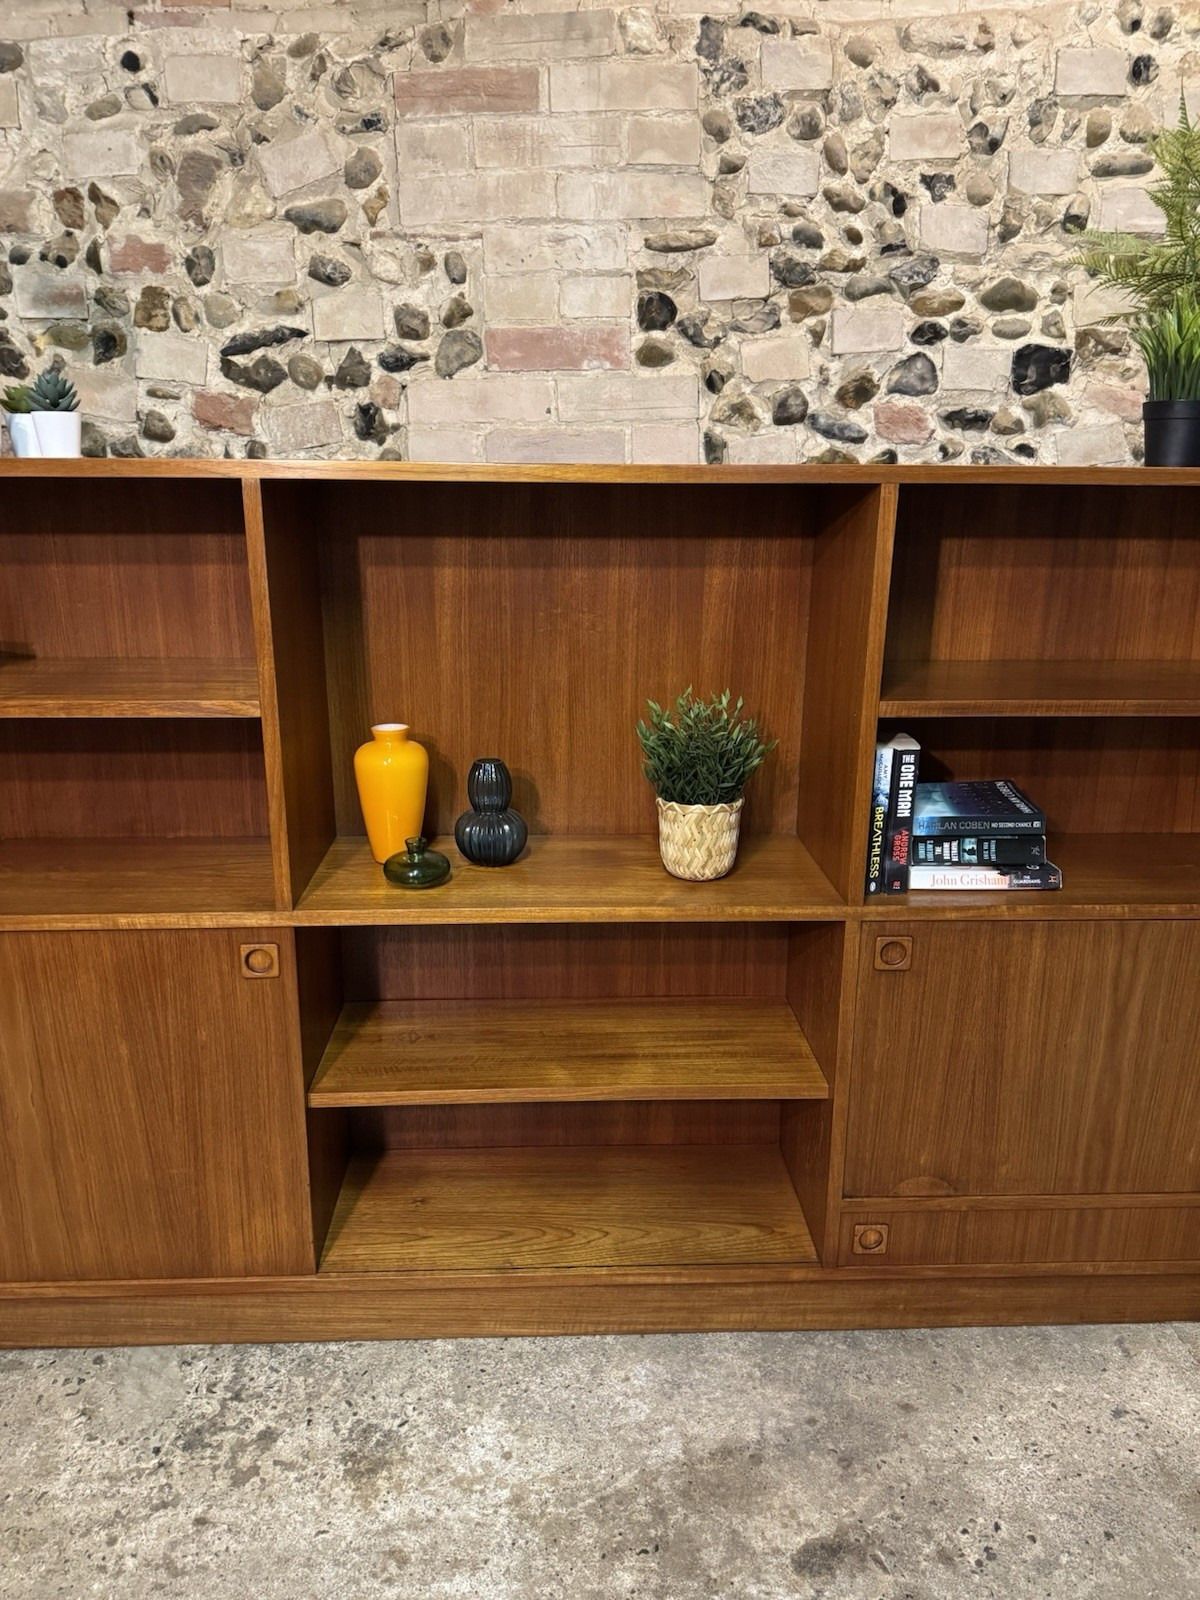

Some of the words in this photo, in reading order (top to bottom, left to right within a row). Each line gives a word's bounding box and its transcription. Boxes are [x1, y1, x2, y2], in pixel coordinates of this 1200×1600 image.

[903, 754, 915, 763] THE
[900, 764, 915, 788] ONE
[897, 791, 912, 818] MAN
[959, 821, 990, 830] COBEN
[869, 806, 885, 879] BREATHLESS
[893, 834, 901, 862] GROSS
[900, 830, 910, 866] ANDREW
[930, 873, 957, 887] John
[960, 873, 1007, 886] Grisham
